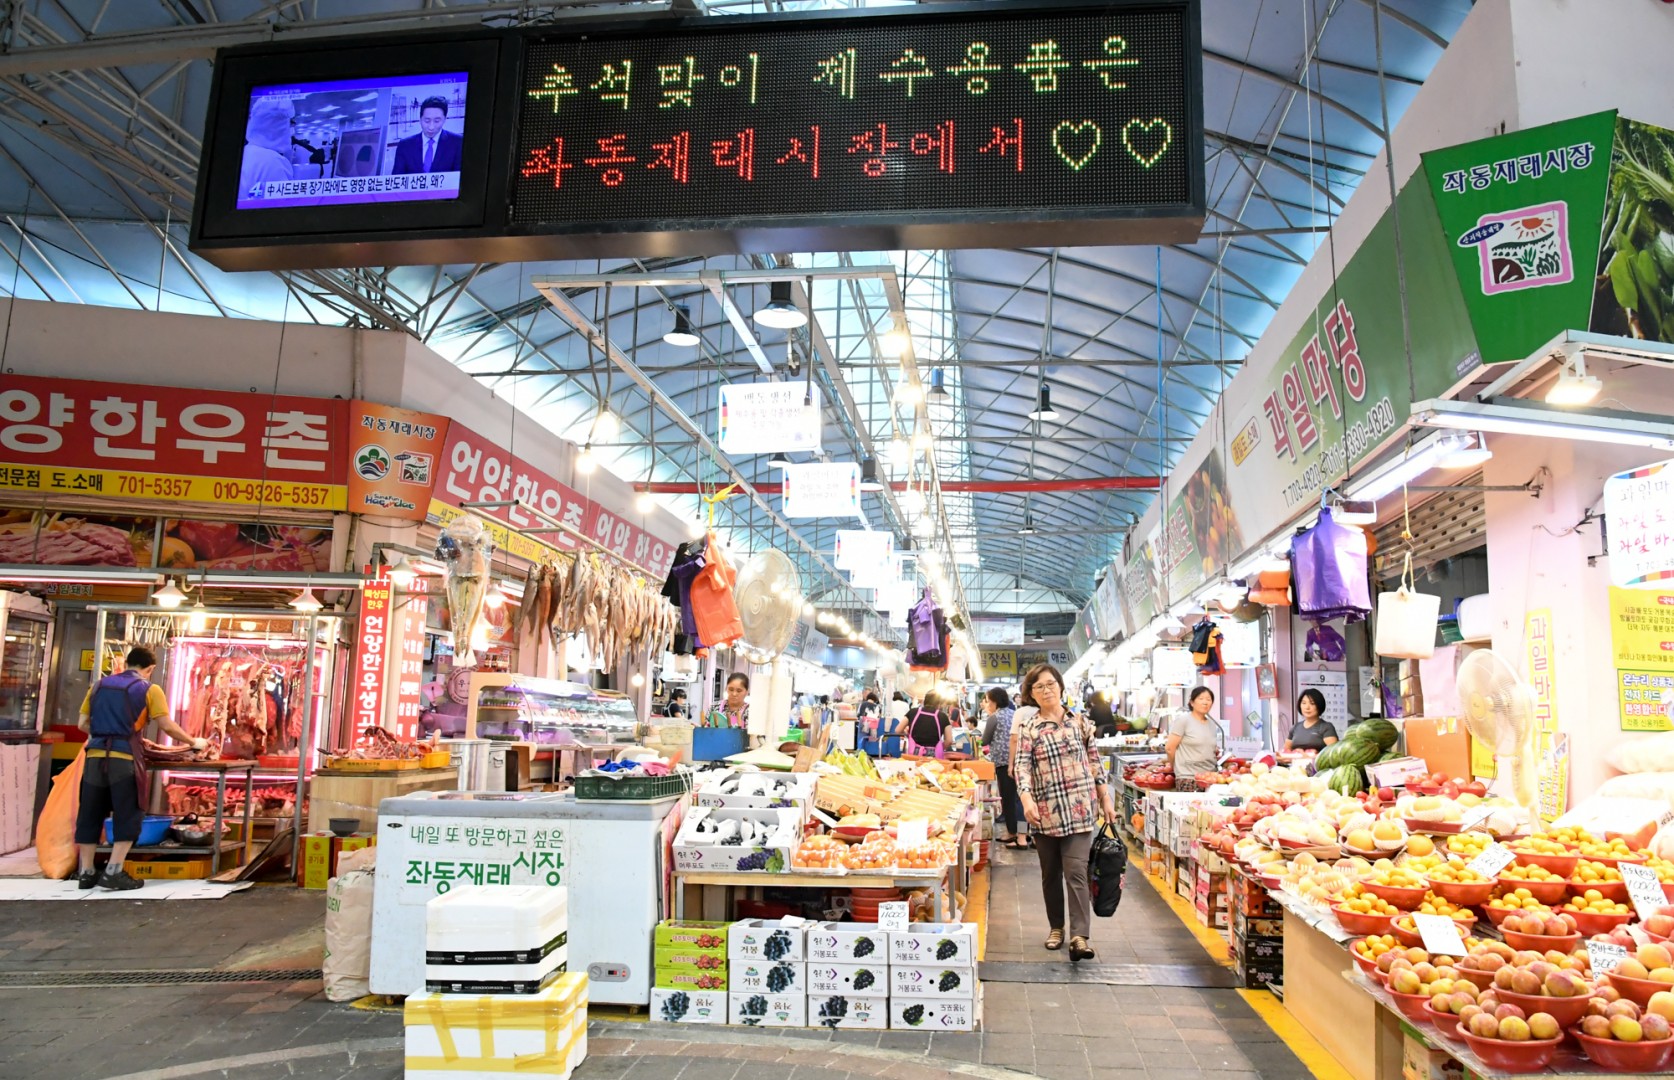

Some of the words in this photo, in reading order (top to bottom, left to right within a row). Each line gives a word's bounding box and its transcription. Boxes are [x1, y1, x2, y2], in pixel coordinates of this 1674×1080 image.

[522, 117, 1023, 188] 좌동재래시장에서
[1442, 141, 1596, 194] 좌동재래시장
[276, 180, 307, 196] 사드보복
[309, 179, 348, 195] 장기화에도
[350, 178, 366, 193] 영향
[367, 178, 384, 192] 없는
[385, 177, 409, 191] 반도체
[430, 174, 445, 188] 왜?
[1263, 298, 1367, 464] 과일마당
[0, 389, 330, 471] 양한우촌
[361, 414, 437, 440] 좌동재래시장
[51, 471, 104, 492] 도.소매
[118, 475, 193, 497] 701-5357
[213, 481, 330, 506] 010-9326-5357
[446, 439, 583, 549] 언양한우촌
[367, 600, 384, 610] 한우
[1624, 703, 1669, 717] 환영합니다
[411, 825, 440, 845] 내일
[446, 827, 460, 842] 또
[465, 827, 527, 847] 방문하고
[533, 829, 564, 849] 싶은
[406, 851, 565, 895] 좌동재래시장
[740, 945, 760, 954] 거봉
[813, 950, 838, 958] 거봉포도
[895, 953, 921, 961] 거봉포도
[742, 977, 761, 986] 거봉
[813, 983, 838, 991] 거봉포도
[897, 985, 923, 993] 거봉포도
